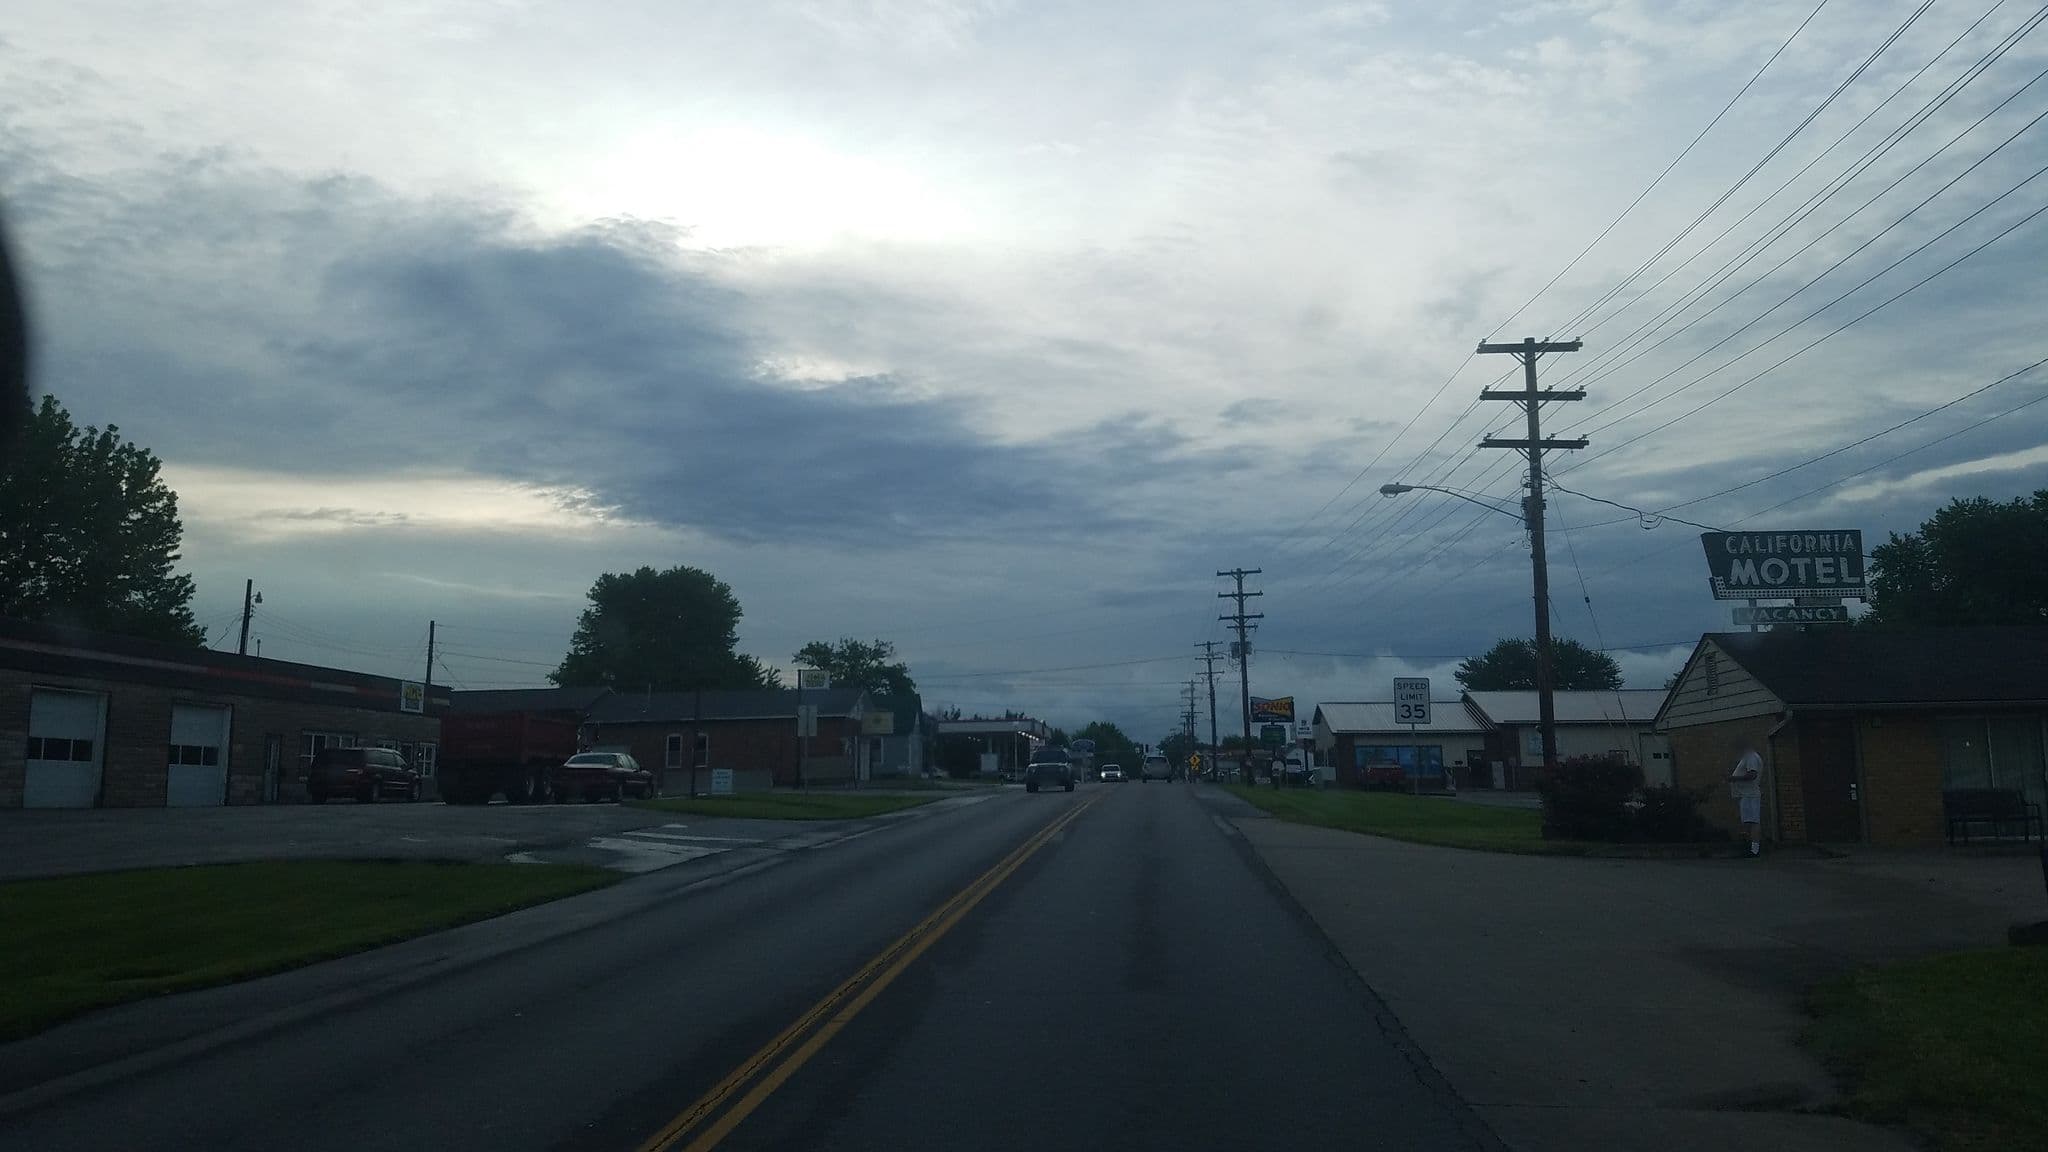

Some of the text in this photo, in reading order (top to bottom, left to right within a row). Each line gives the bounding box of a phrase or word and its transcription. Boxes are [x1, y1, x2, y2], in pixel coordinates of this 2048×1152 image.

[1725, 535, 1857, 553] CALIFORNIA
[1730, 556, 1861, 586] MOTEL
[1751, 608, 1840, 621] VACANCY
[1397, 682, 1427, 690] SPEED
[1400, 693, 1423, 701] LIMIT
[1400, 704, 1426, 719] 35
